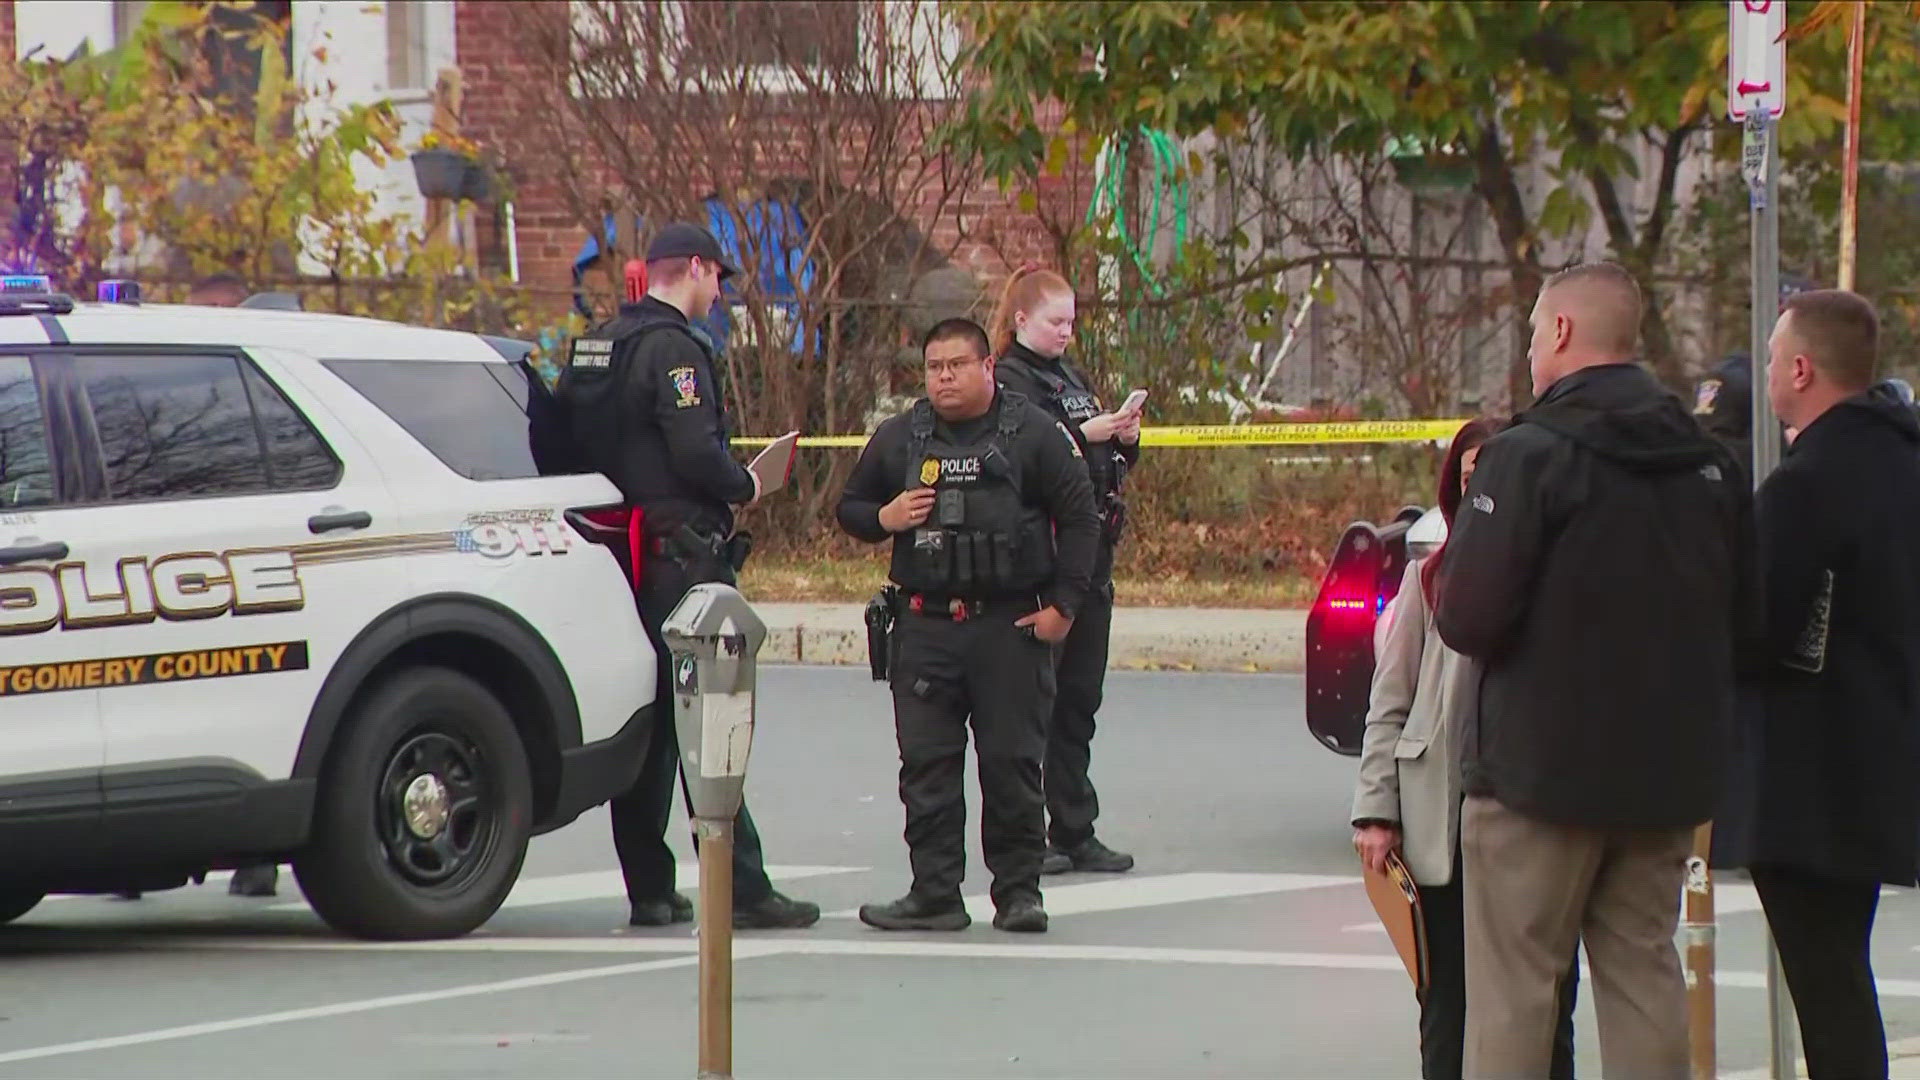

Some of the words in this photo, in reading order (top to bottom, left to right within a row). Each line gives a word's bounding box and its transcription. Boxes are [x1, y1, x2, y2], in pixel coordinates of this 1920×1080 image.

[1179, 427, 1242, 435] POLICE
[1248, 426, 1283, 434] LINE
[1295, 425, 1319, 433] DO
[1325, 424, 1359, 432] NOT
[1368, 423, 1427, 432] CROSS
[941, 457, 980, 473] POLICE
[471, 521, 570, 559] 911
[154, 644, 289, 680] COUNTY
